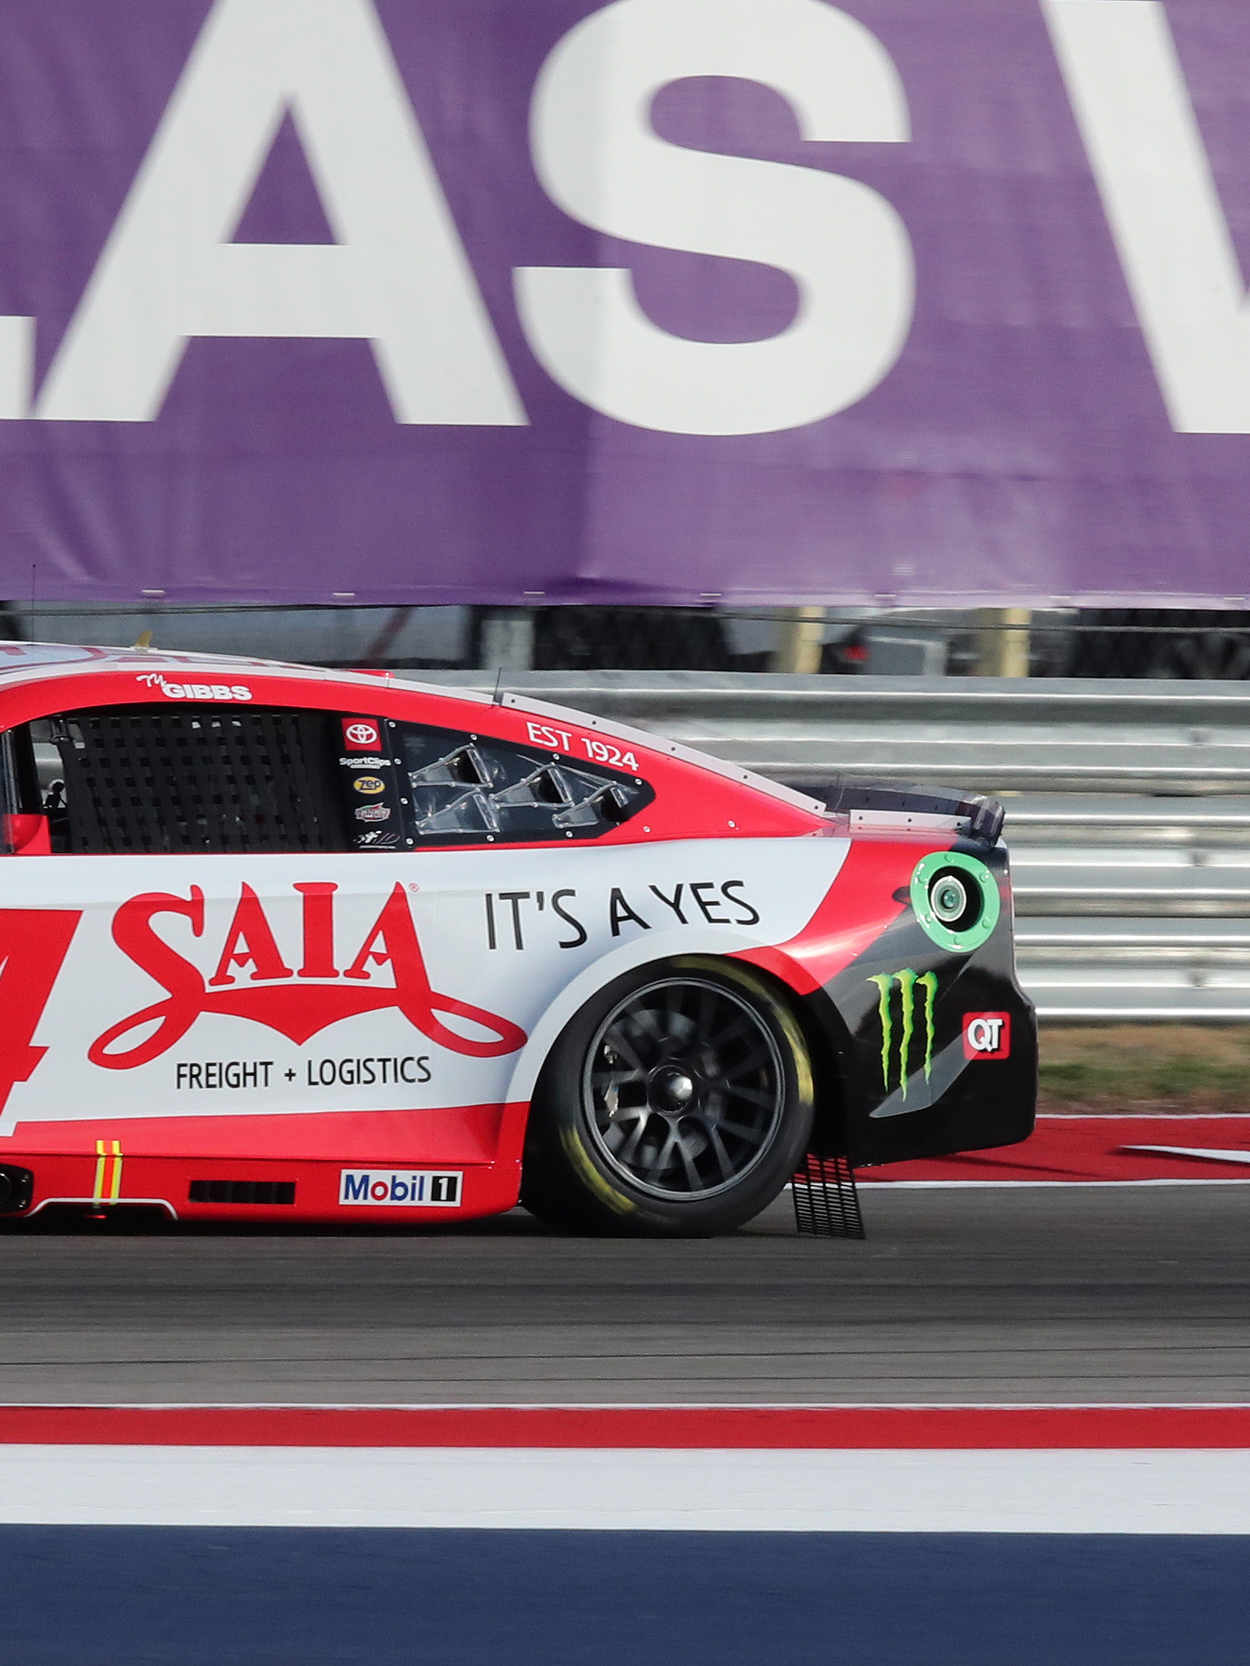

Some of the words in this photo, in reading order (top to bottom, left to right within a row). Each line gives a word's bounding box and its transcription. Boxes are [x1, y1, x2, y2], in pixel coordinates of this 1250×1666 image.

[162, 683, 253, 701] GIBBS
[526, 722, 572, 751] EST
[581, 737, 640, 772] 1924
[485, 888, 588, 950] IT'S
[609, 886, 652, 937] A
[650, 880, 761, 926] YES
[88, 881, 528, 1070] SAIA
[967, 1018, 1004, 1052] QT
[176, 1061, 274, 1089] FREIGHT
[307, 1056, 432, 1086] LOGISTICS
[344, 1174, 425, 1202] Mobil
[438, 1177, 449, 1201] 1
